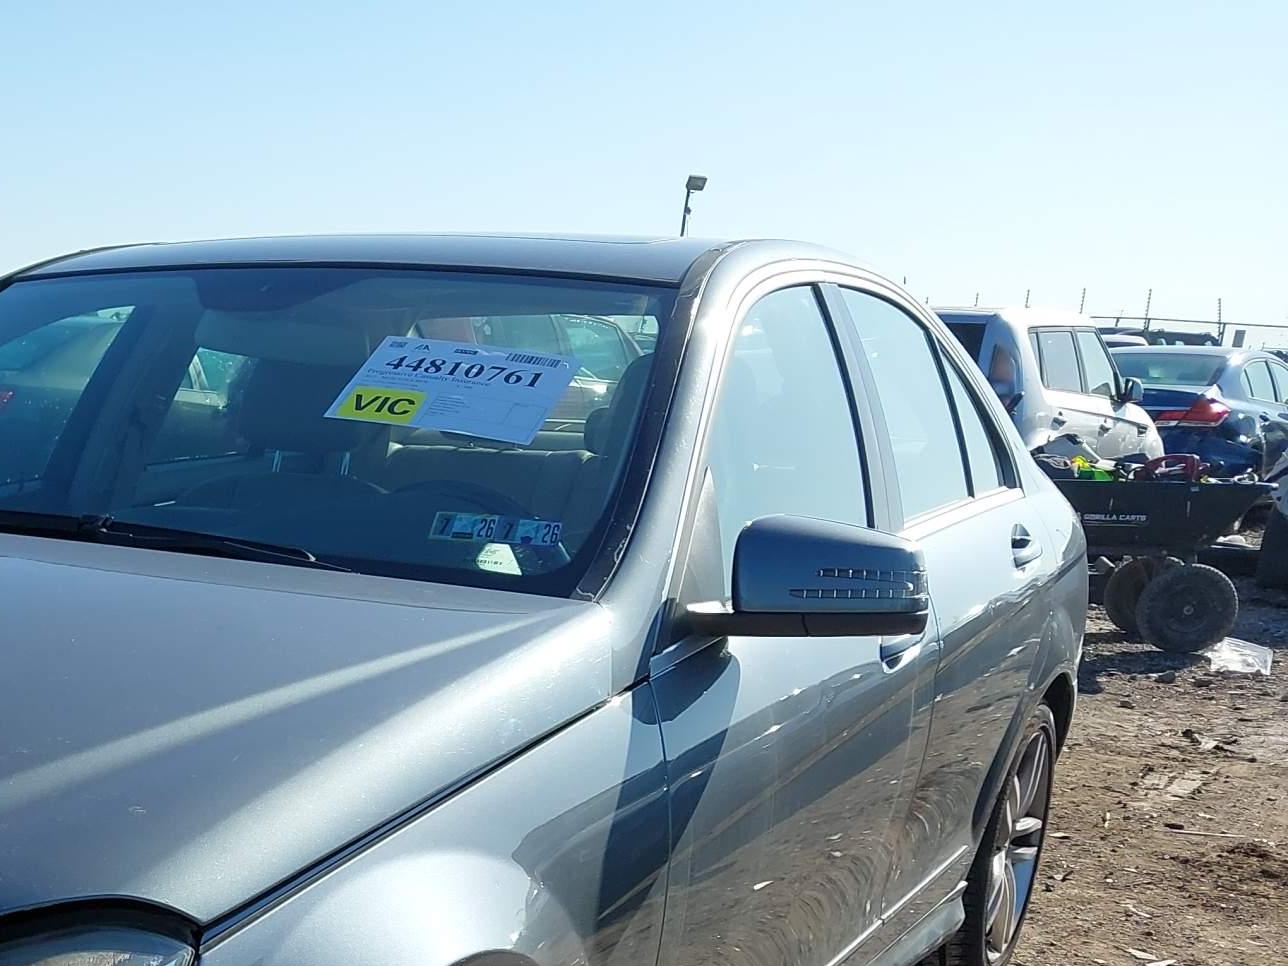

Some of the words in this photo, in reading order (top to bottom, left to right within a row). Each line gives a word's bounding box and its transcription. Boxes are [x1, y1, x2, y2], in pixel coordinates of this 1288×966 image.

[386, 354, 545, 388] 44810761
[353, 394, 416, 416] VIC
[477, 518, 496, 539] 26
[542, 524, 560, 544] 26
